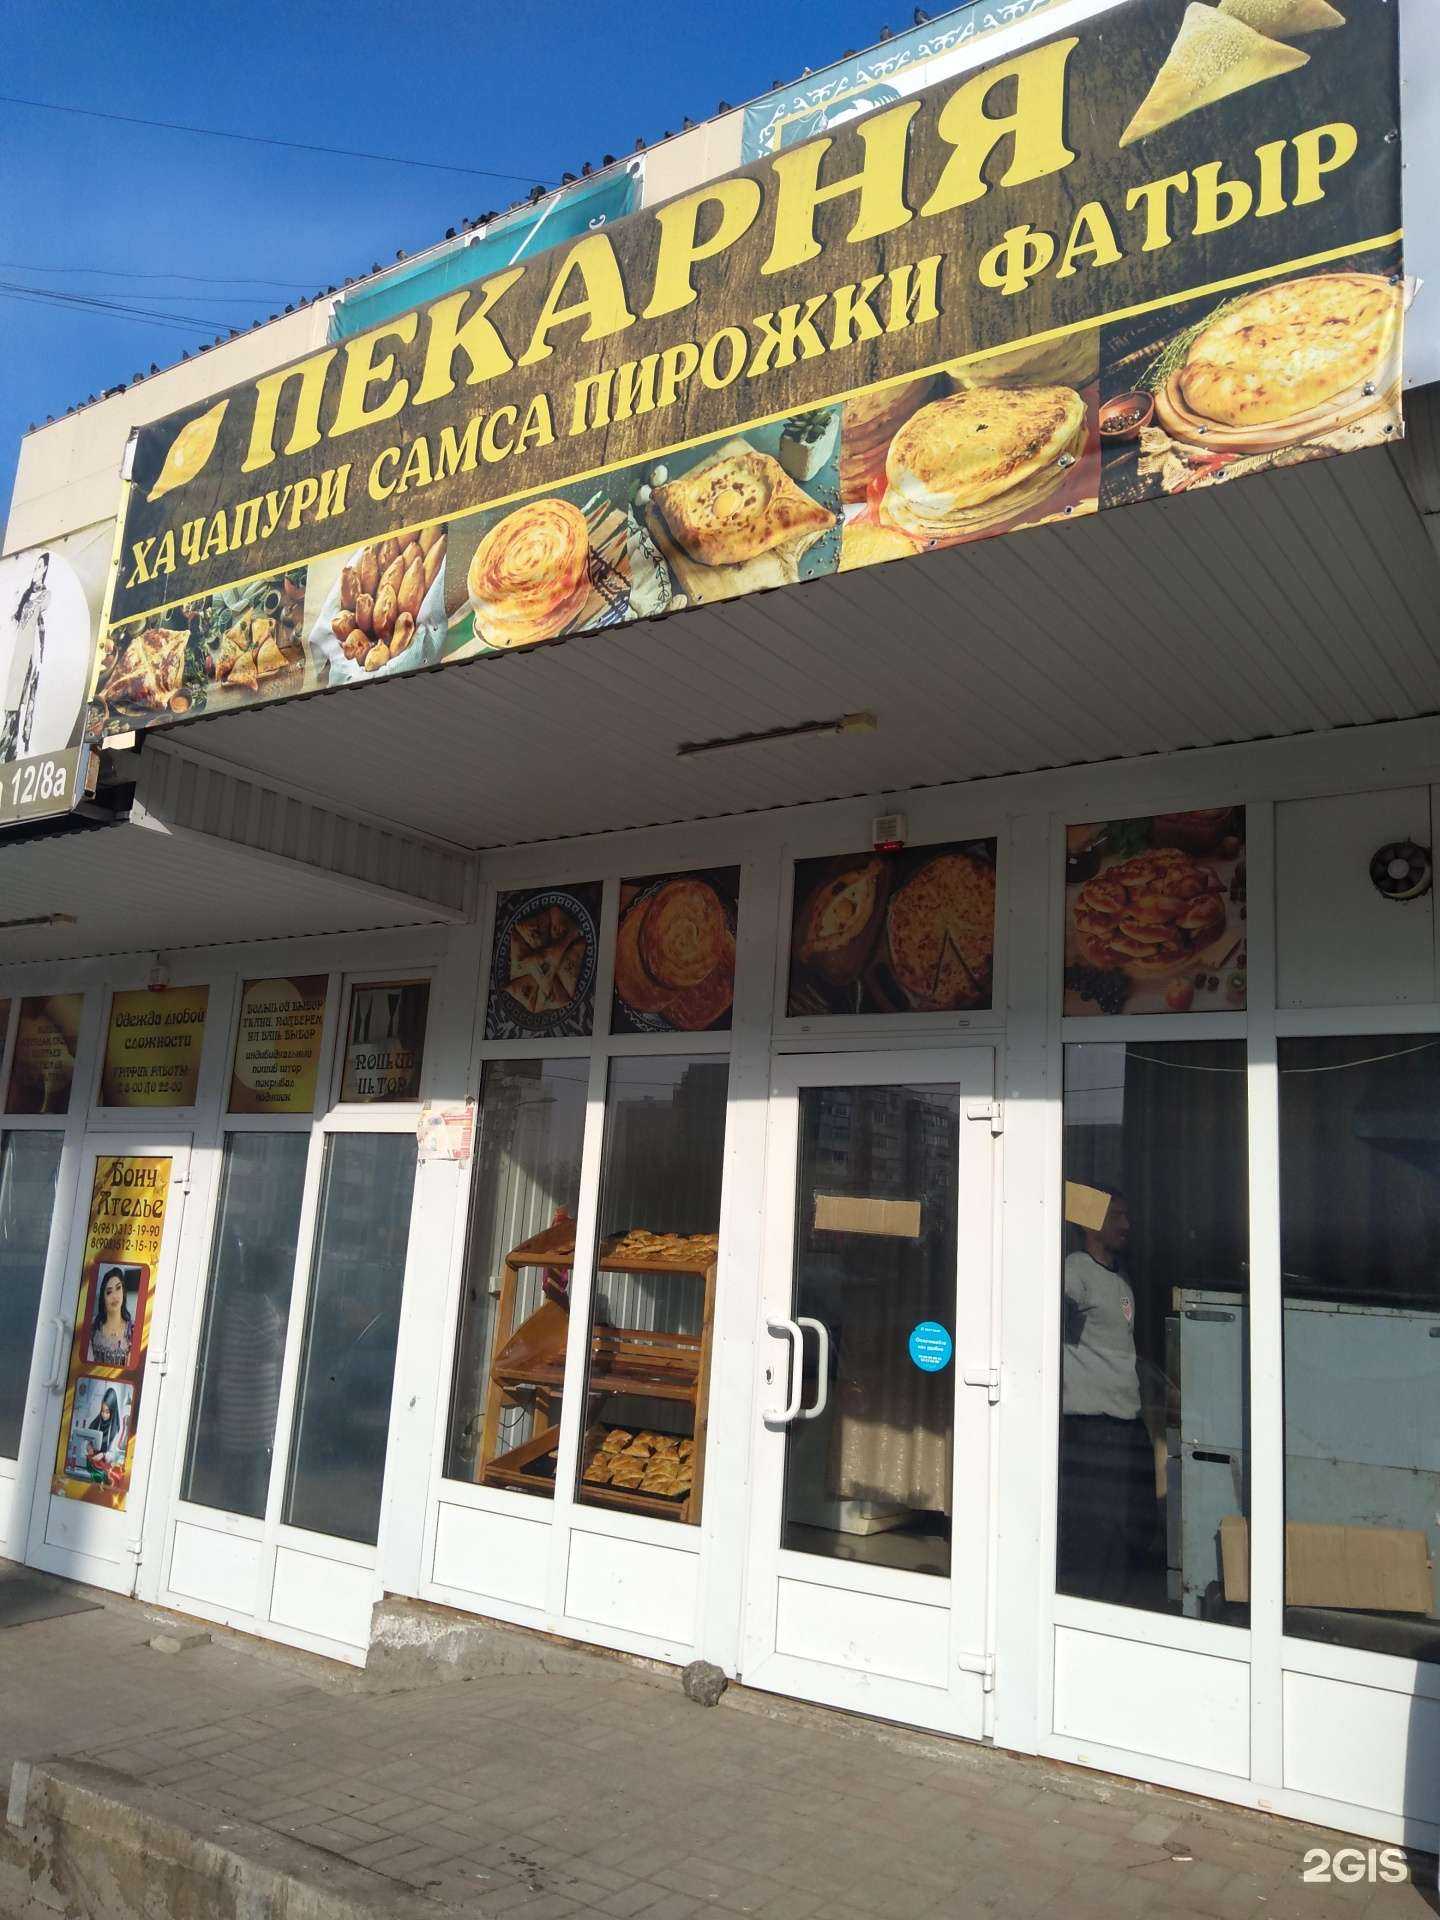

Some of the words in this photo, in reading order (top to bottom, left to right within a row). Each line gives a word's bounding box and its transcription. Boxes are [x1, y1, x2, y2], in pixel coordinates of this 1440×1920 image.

[239, 37, 1079, 473] ПЕКАРНЯ
[125, 462, 352, 589] ХАЧАПУРИ
[368, 393, 556, 501] САМСА
[569, 254, 943, 437] ПИРОЖКИ
[978, 122, 1359, 296] ФАТЫР
[12, 761, 67, 805] 12/8а
[115, 1010, 162, 1028] Одежда
[165, 1008, 207, 1025] любой
[124, 1035, 192, 1049] сложности
[111, 1161, 158, 1188] Бону
[97, 1190, 164, 1218] Ателье
